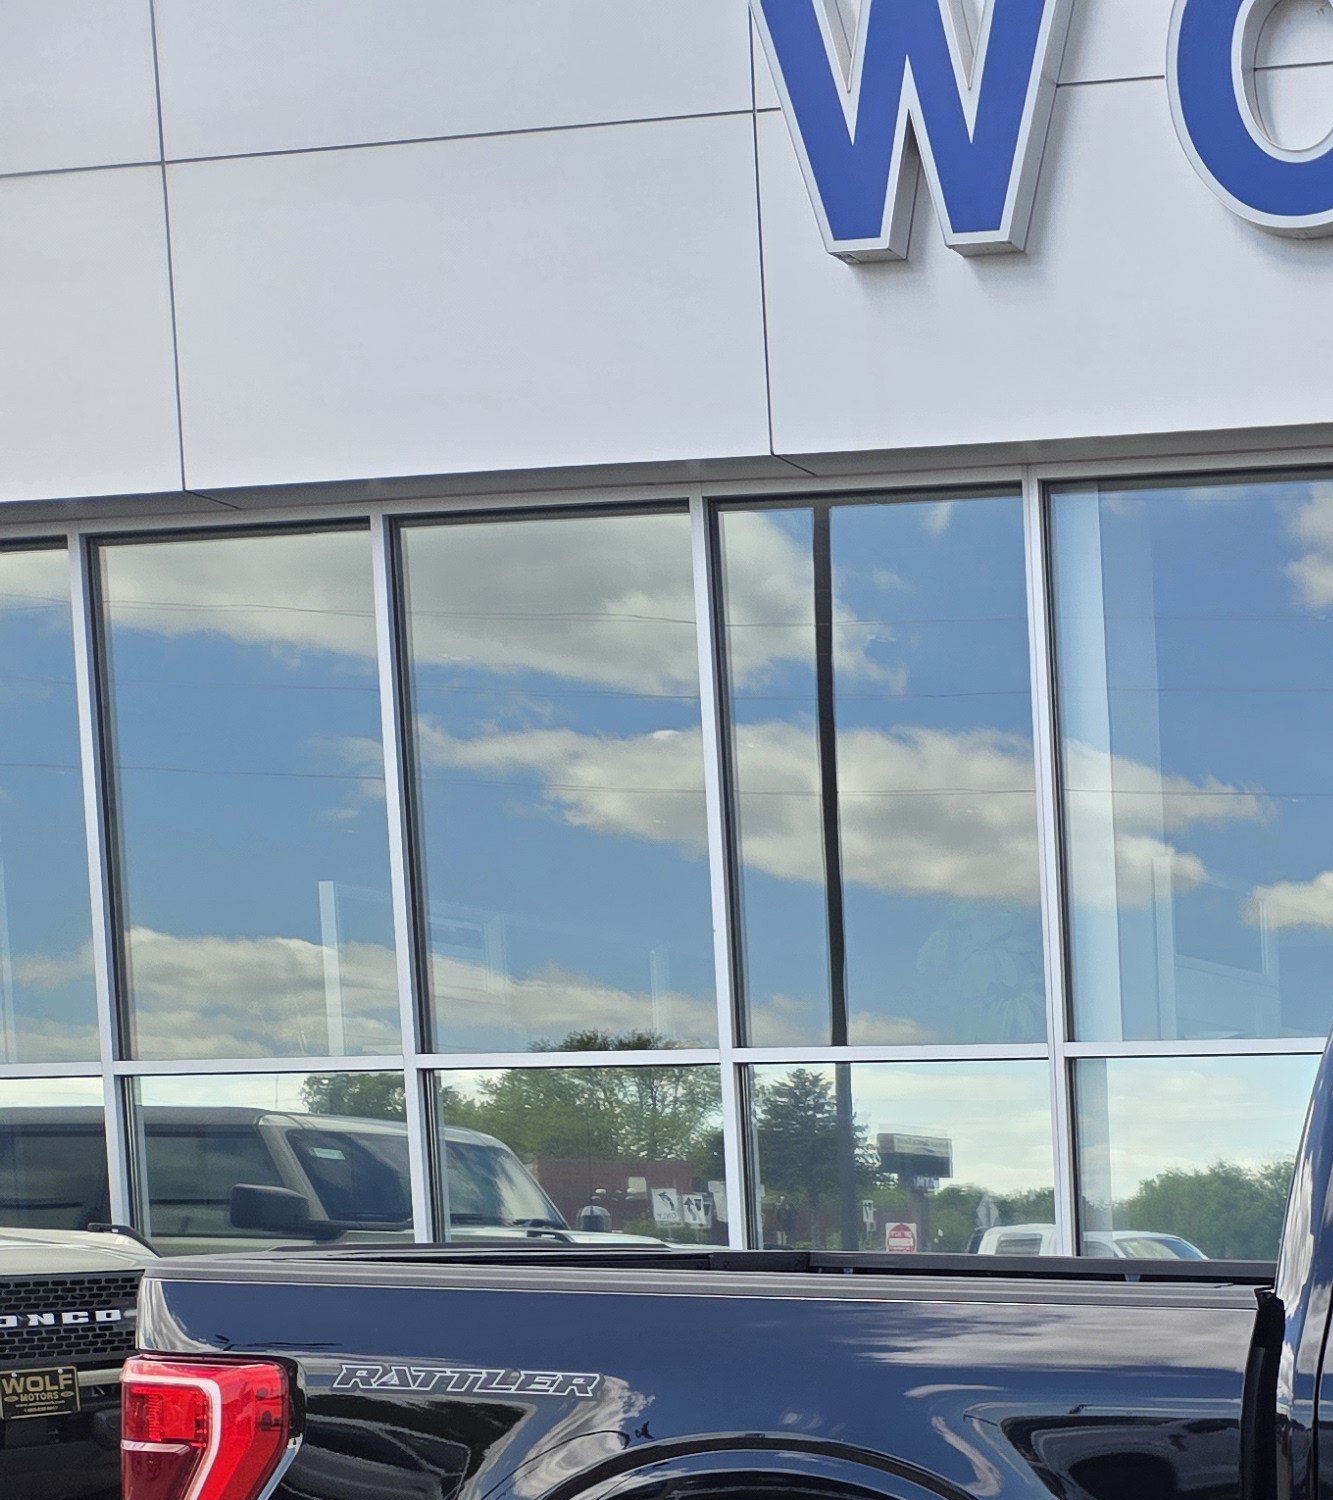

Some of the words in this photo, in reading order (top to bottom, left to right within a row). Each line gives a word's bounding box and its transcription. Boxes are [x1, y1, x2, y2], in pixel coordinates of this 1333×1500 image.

[2, 1373, 73, 1395] WOLF
[331, 1364, 601, 1398] RATTLER
[20, 1391, 59, 1402] MOTORS
